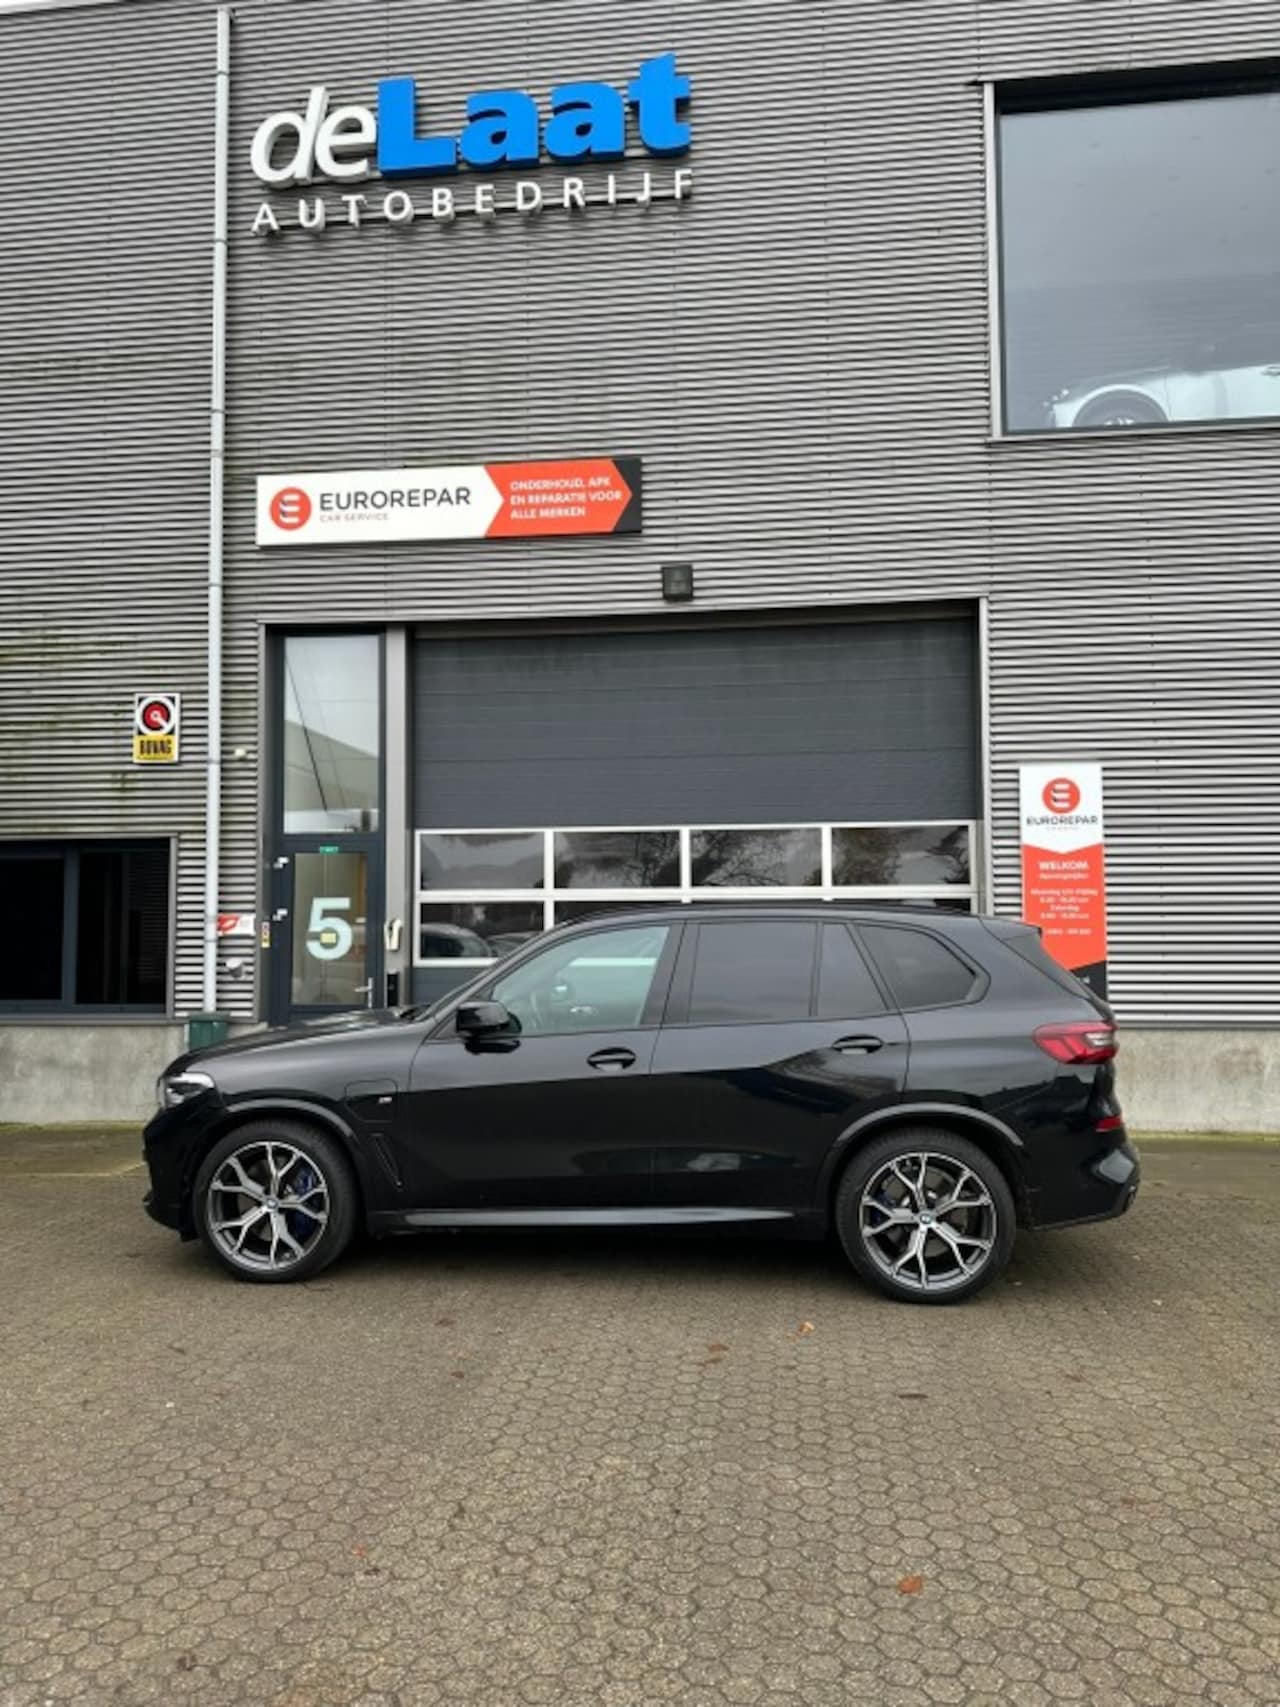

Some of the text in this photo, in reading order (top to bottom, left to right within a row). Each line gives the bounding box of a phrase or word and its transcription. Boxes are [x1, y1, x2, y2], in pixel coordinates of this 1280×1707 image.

[251, 168, 693, 234] AUTOBEDRIJF
[588, 476, 611, 488] APK
[320, 486, 471, 511] EUROREPAR
[510, 490, 622, 505] EN REPARATIE VOOR
[320, 512, 388, 523] CAR SERVICE
[510, 506, 585, 519] ALLE MERKEN
[1026, 815, 1099, 825] EUROREPAR
[1038, 861, 1089, 870] WELKOM
[305, 896, 353, 961] 5
